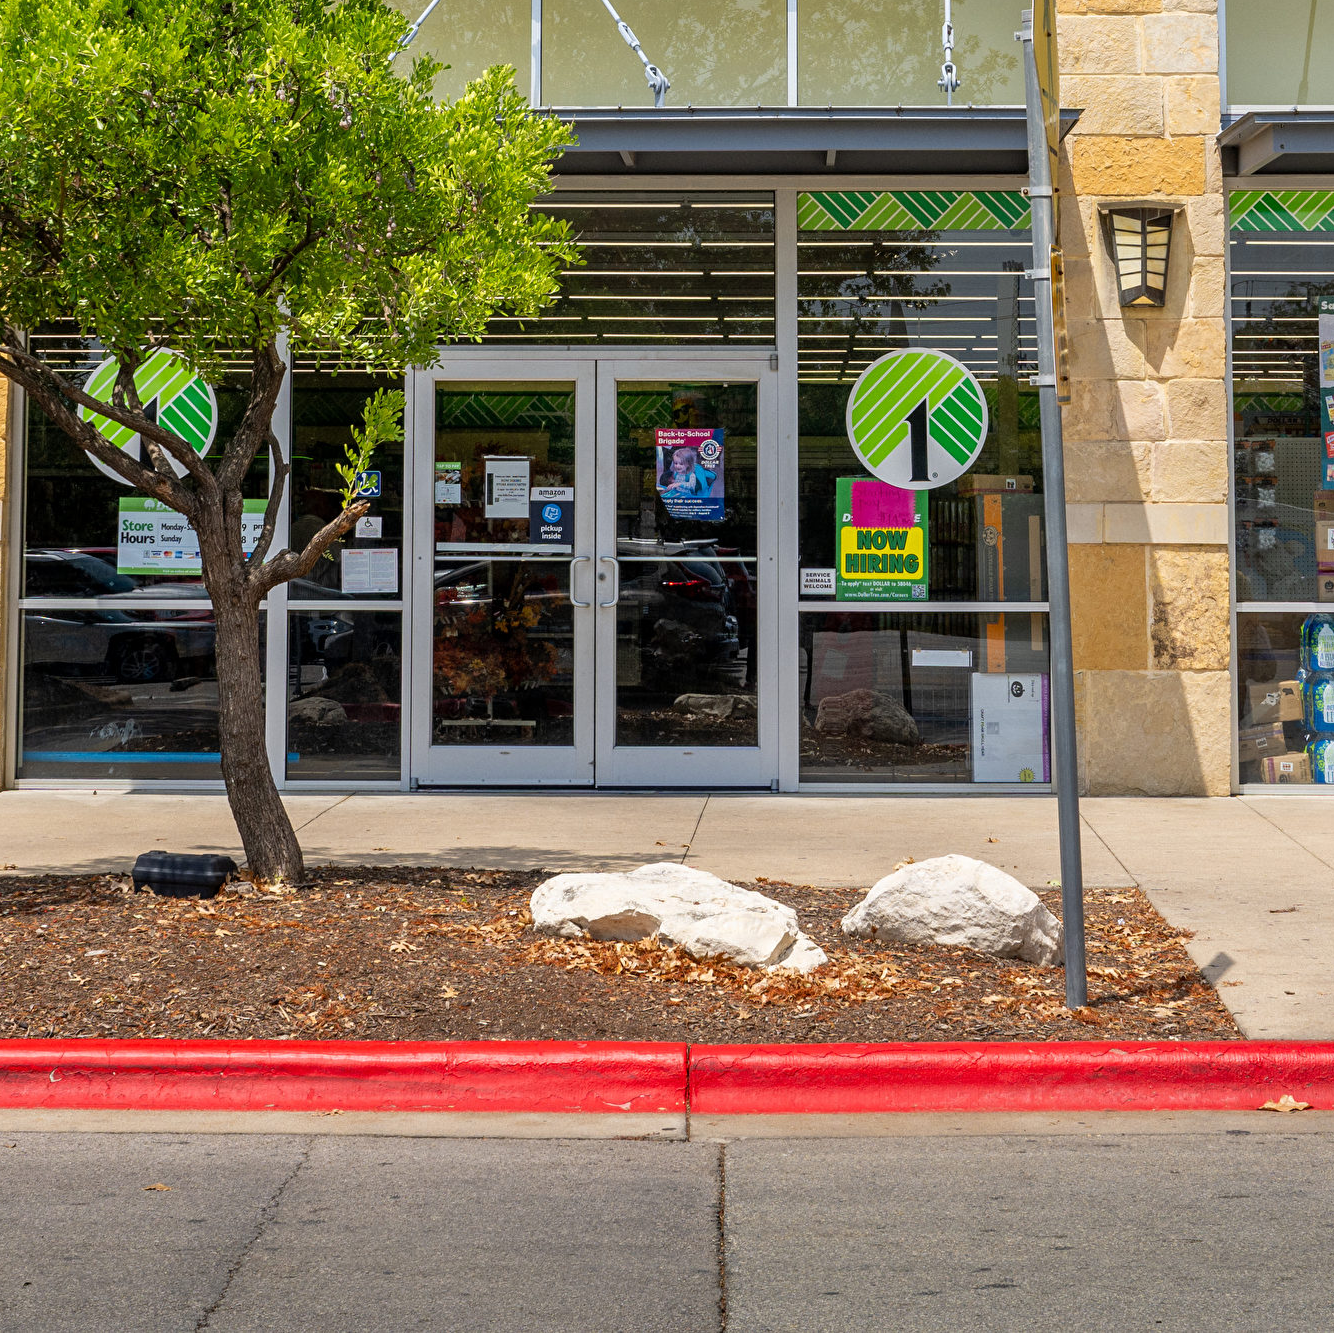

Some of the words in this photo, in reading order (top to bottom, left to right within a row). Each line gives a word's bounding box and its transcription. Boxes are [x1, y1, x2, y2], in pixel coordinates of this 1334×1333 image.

[122, 519, 153, 531] Store
[161, 523, 196, 532] Monday-S
[540, 525, 563, 533] pickup
[121, 532, 155, 544] Hours
[161, 536, 182, 544] Sunday
[857, 530, 908, 550] NOW
[845, 553, 919, 574] HIRING
